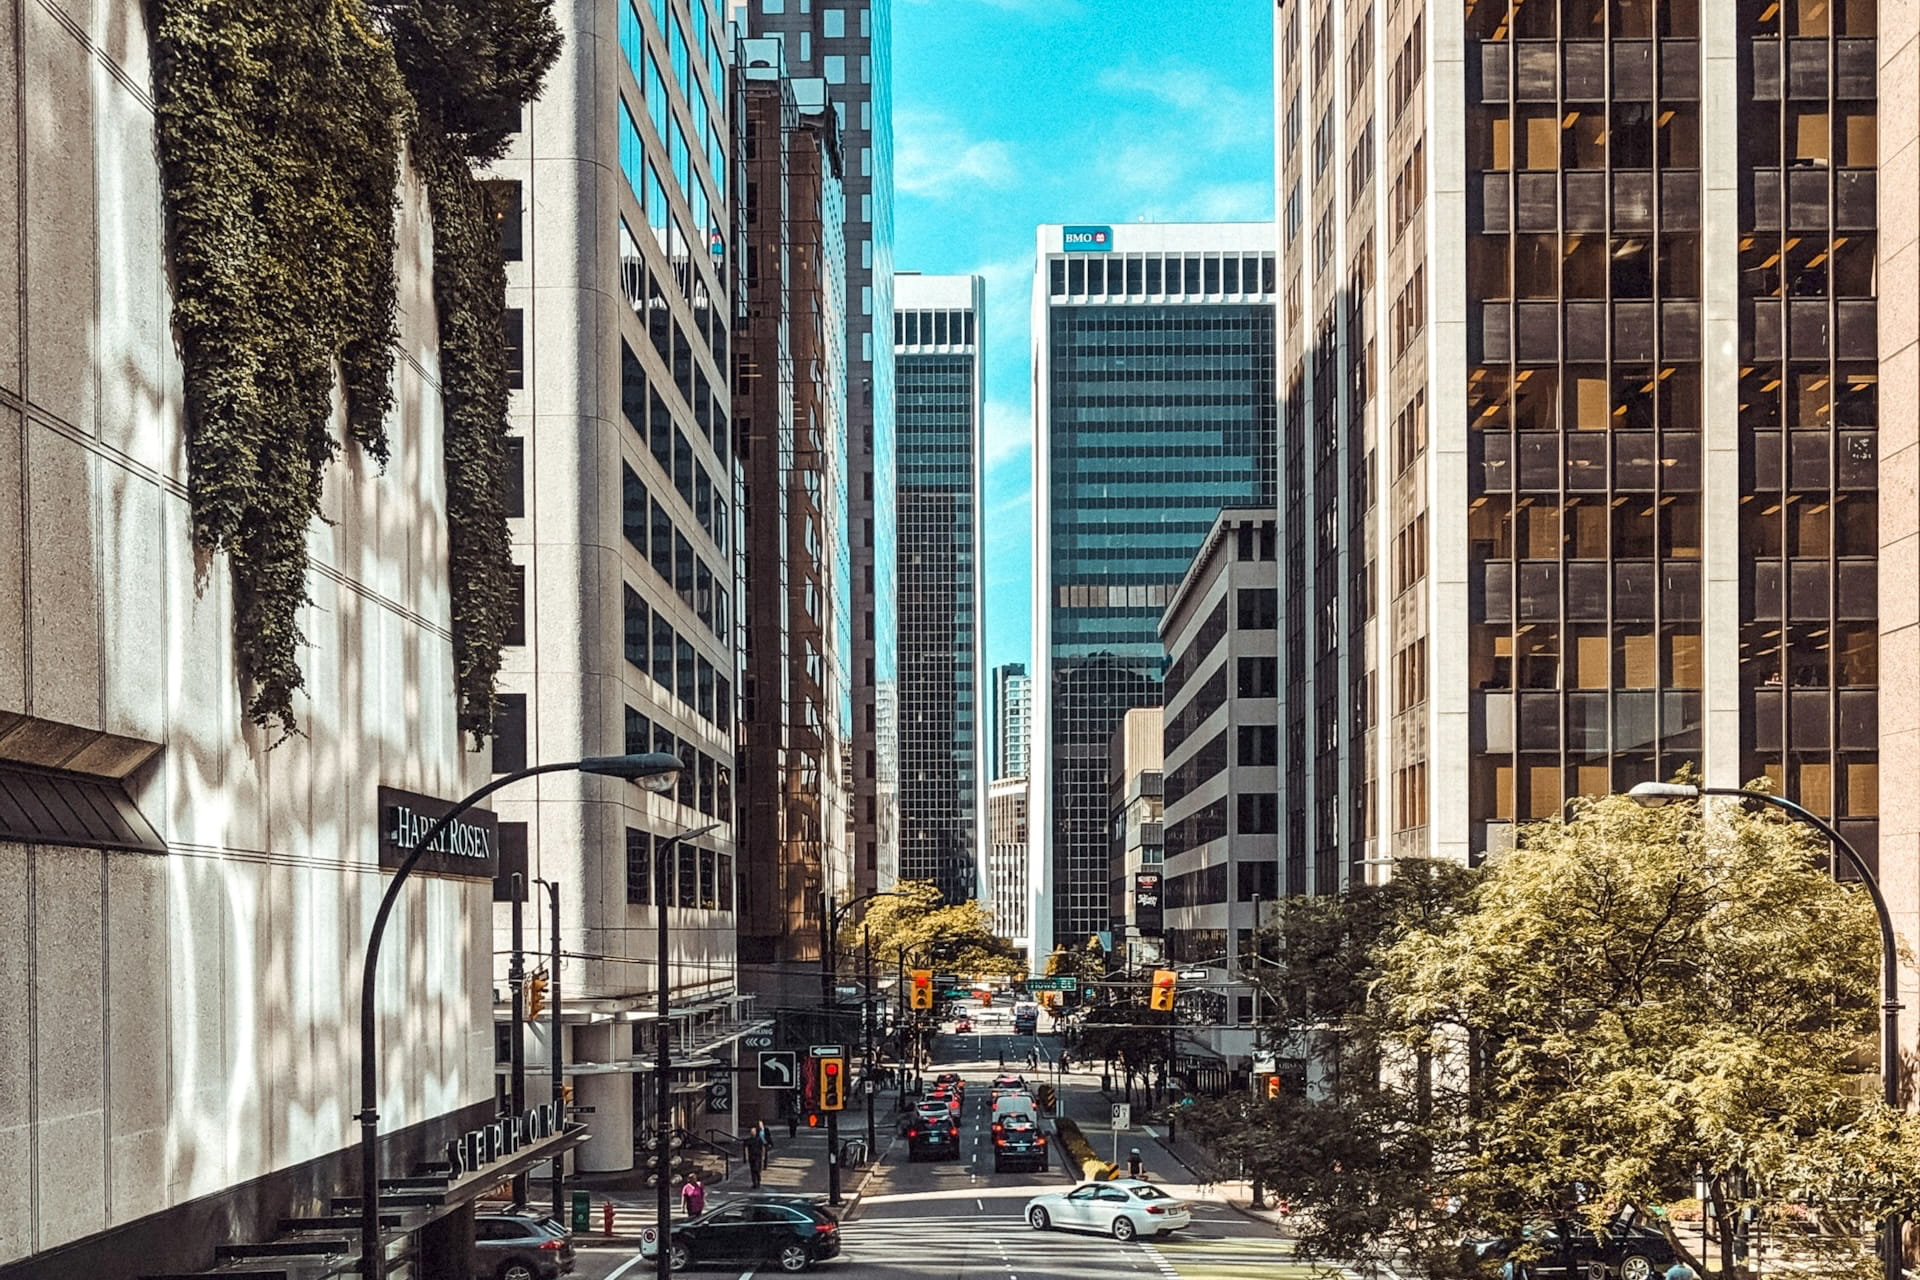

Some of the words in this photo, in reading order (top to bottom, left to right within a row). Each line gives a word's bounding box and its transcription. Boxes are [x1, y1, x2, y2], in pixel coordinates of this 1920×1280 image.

[1065, 233, 1092, 243] BMO
[450, 817, 490, 859] ROSEN
[450, 1100, 570, 1180] SEPHORA
